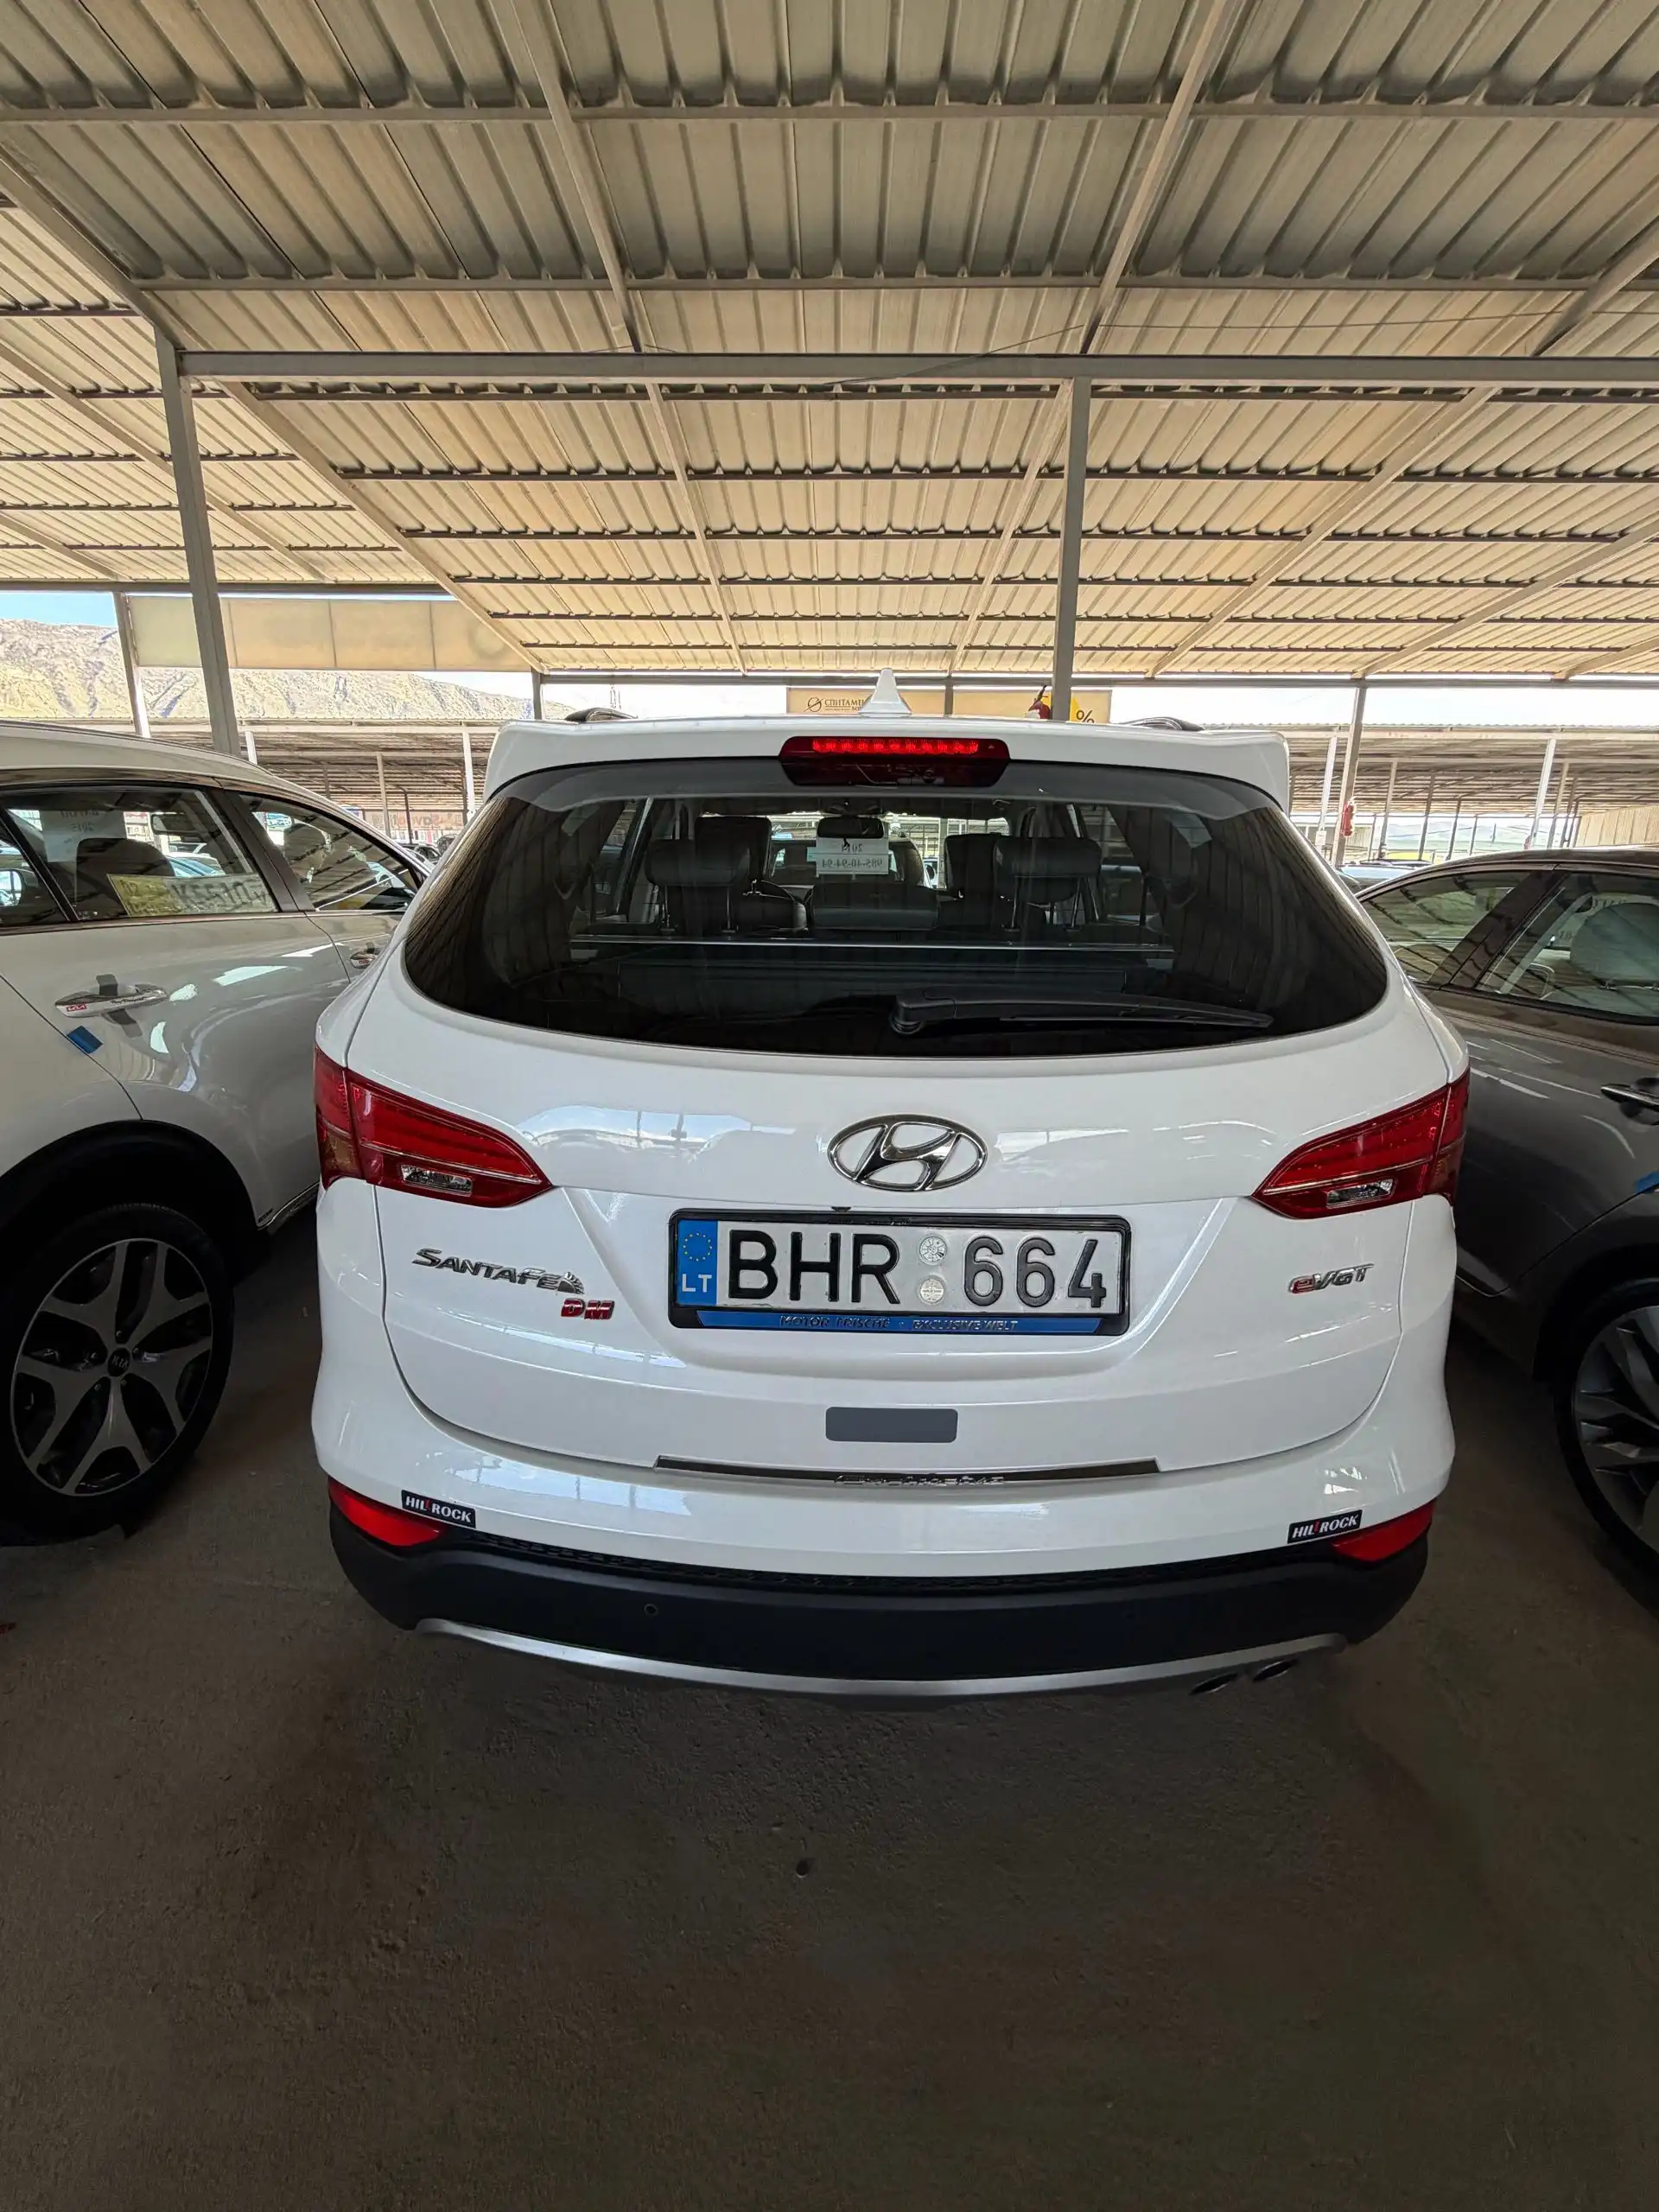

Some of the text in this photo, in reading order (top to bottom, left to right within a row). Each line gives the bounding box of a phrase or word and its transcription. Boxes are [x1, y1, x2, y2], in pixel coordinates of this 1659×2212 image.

[728, 1229, 1107, 1308] BHR 664
[682, 1274, 713, 1293] LT
[560, 1297, 615, 1320] DM
